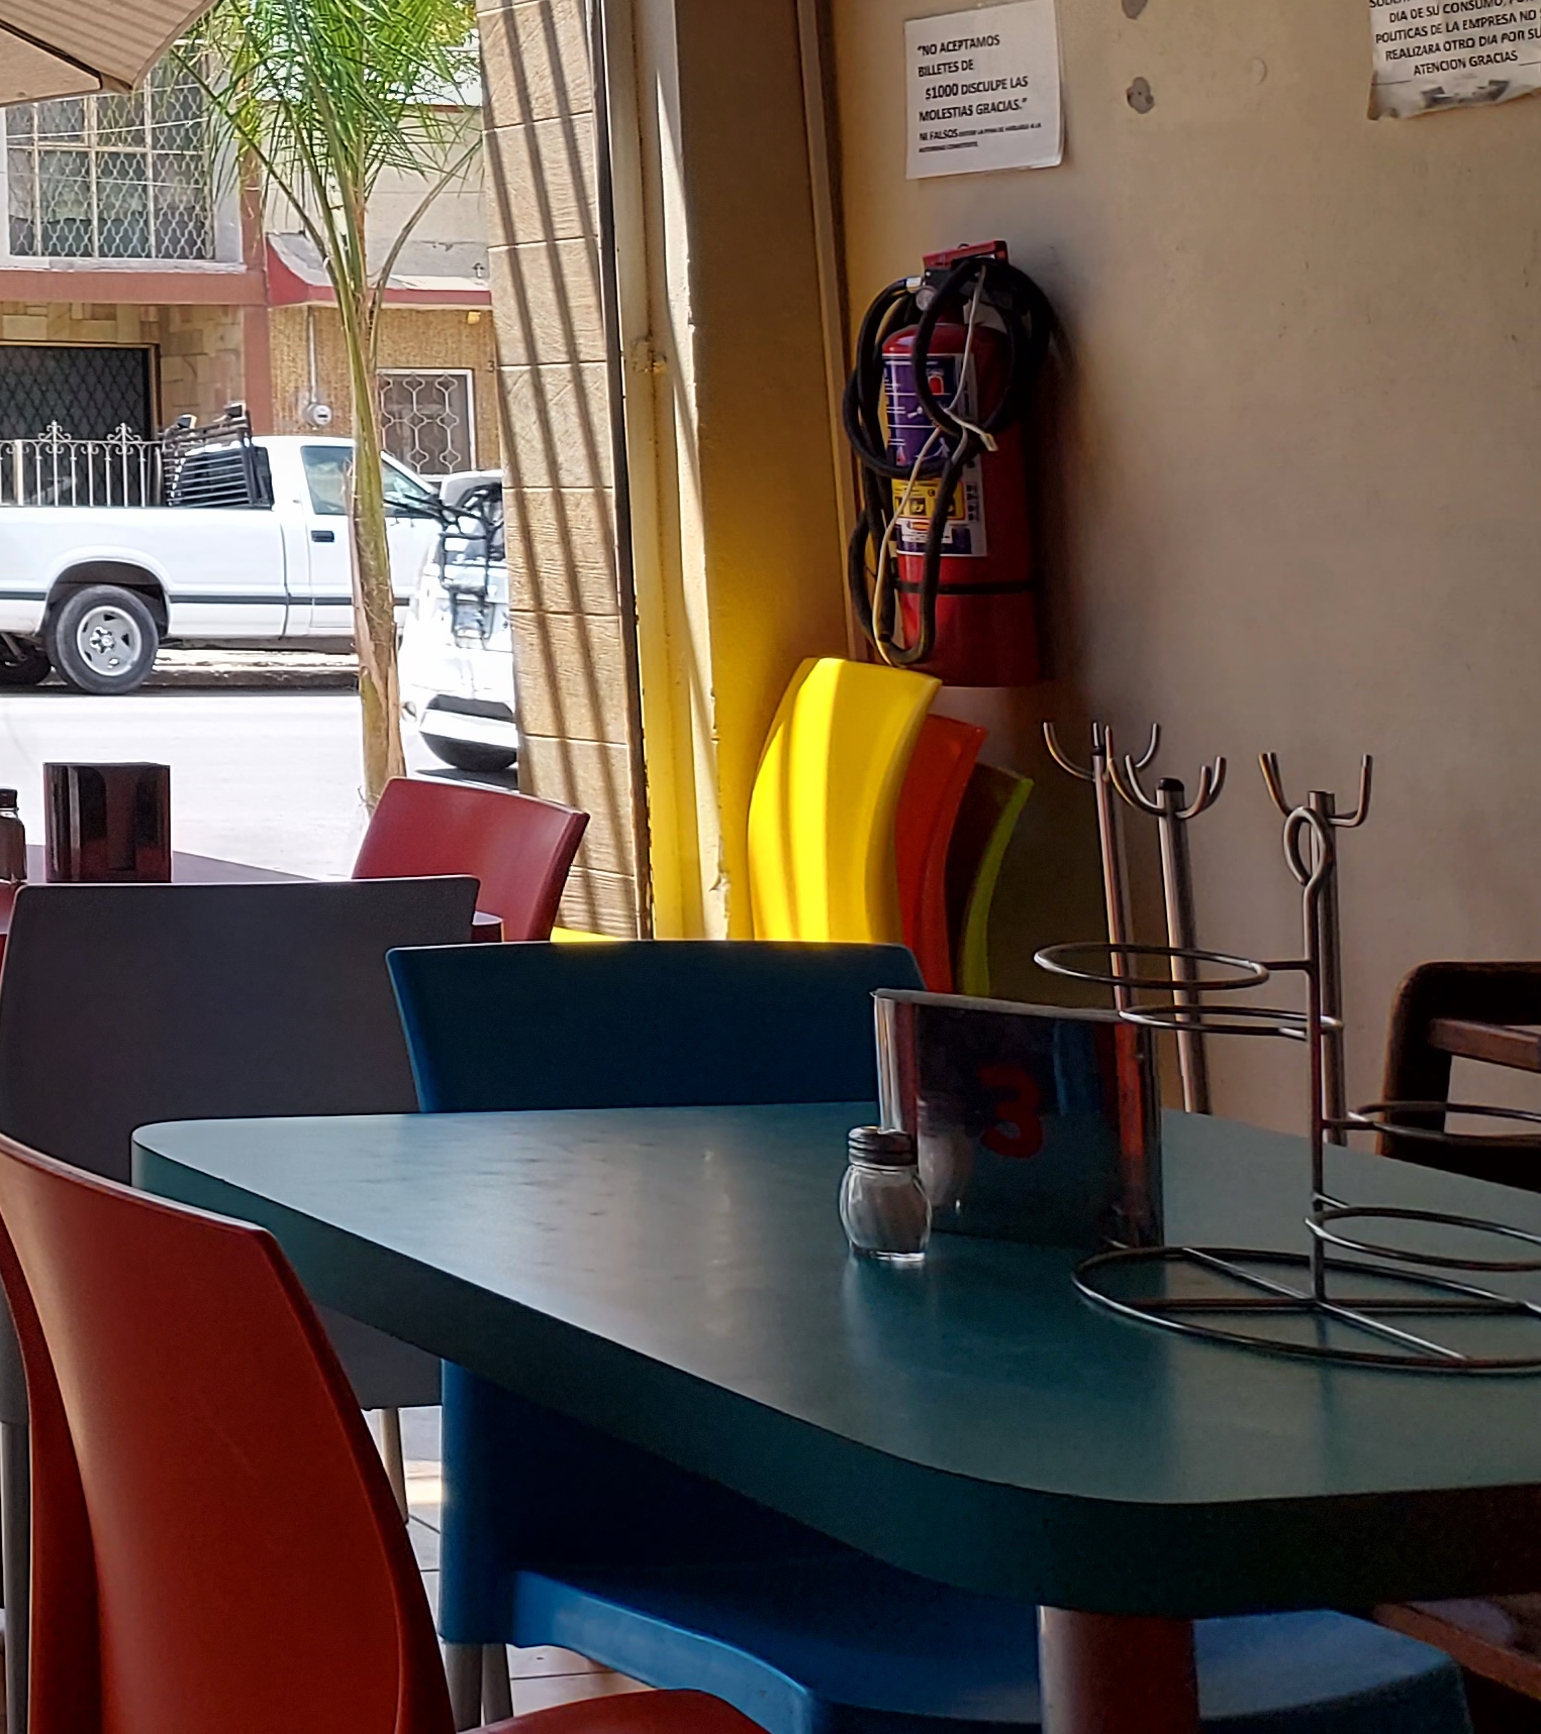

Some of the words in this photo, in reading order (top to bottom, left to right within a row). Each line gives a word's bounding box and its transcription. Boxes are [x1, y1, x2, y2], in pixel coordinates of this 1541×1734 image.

[1375, 26, 1428, 44] POLITICAS
[1430, 23, 1443, 36] DE
[1446, 20, 1460, 33] LA
[1462, 11, 1517, 30] EMPRESA
[1519, 9, 1537, 22] NO
[1389, 10, 1408, 23] DIA
[1410, 8, 1424, 20] DE
[1426, 5, 1440, 18] SU
[939, 34, 1001, 54] ACEPTAMOS
[1386, 44, 1441, 62] REALIZARA
[1443, 37, 1476, 52] OTRO
[1478, 34, 1498, 47] DIA
[1500, 29, 1526, 44] POR
[918, 61, 960, 78] BILLETES
[961, 58, 975, 72] DE
[1413, 57, 1466, 76] ATENCION
[1468, 50, 1518, 67] GRACIAS
[925, 83, 959, 101] $1000
[961, 78, 1008, 96] DISCULPE
[1010, 76, 1029, 89] LAS
[919, 104, 974, 122] MOLESTIAS
[975, 1064, 1044, 1159] 3
